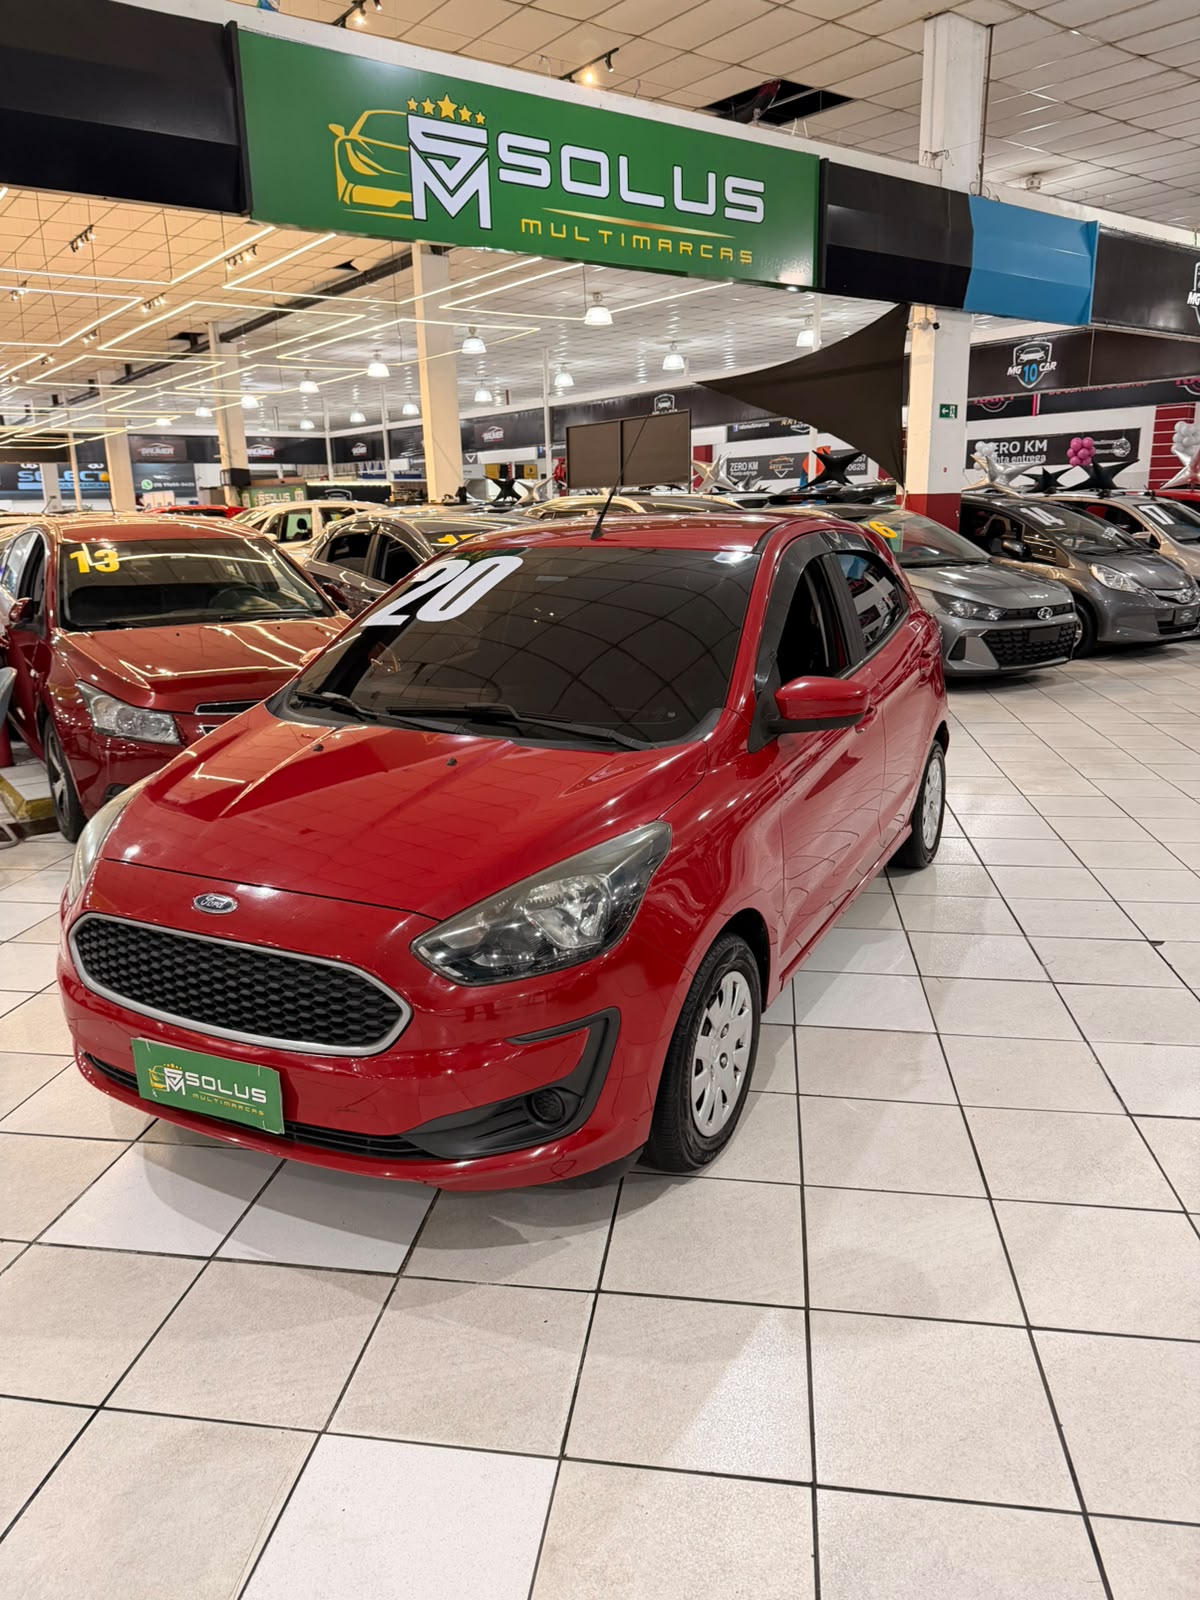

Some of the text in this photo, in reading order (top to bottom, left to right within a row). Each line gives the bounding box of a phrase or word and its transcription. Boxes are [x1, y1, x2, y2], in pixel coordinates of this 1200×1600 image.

[498, 132, 765, 224] SOLUS
[521, 218, 753, 264] MULTIMARCAS
[1007, 361, 1057, 382] MG 10 CAR
[993, 440, 1048, 454] ERO KM
[730, 462, 748, 472] ZERO
[748, 461, 759, 471] KM
[1020, 506, 1066, 526] 14
[69, 549, 120, 574] 13
[360, 556, 523, 628] 20
[185, 1071, 267, 1104] SOLUS
[192, 1093, 264, 1116] MULTIMARCAS
